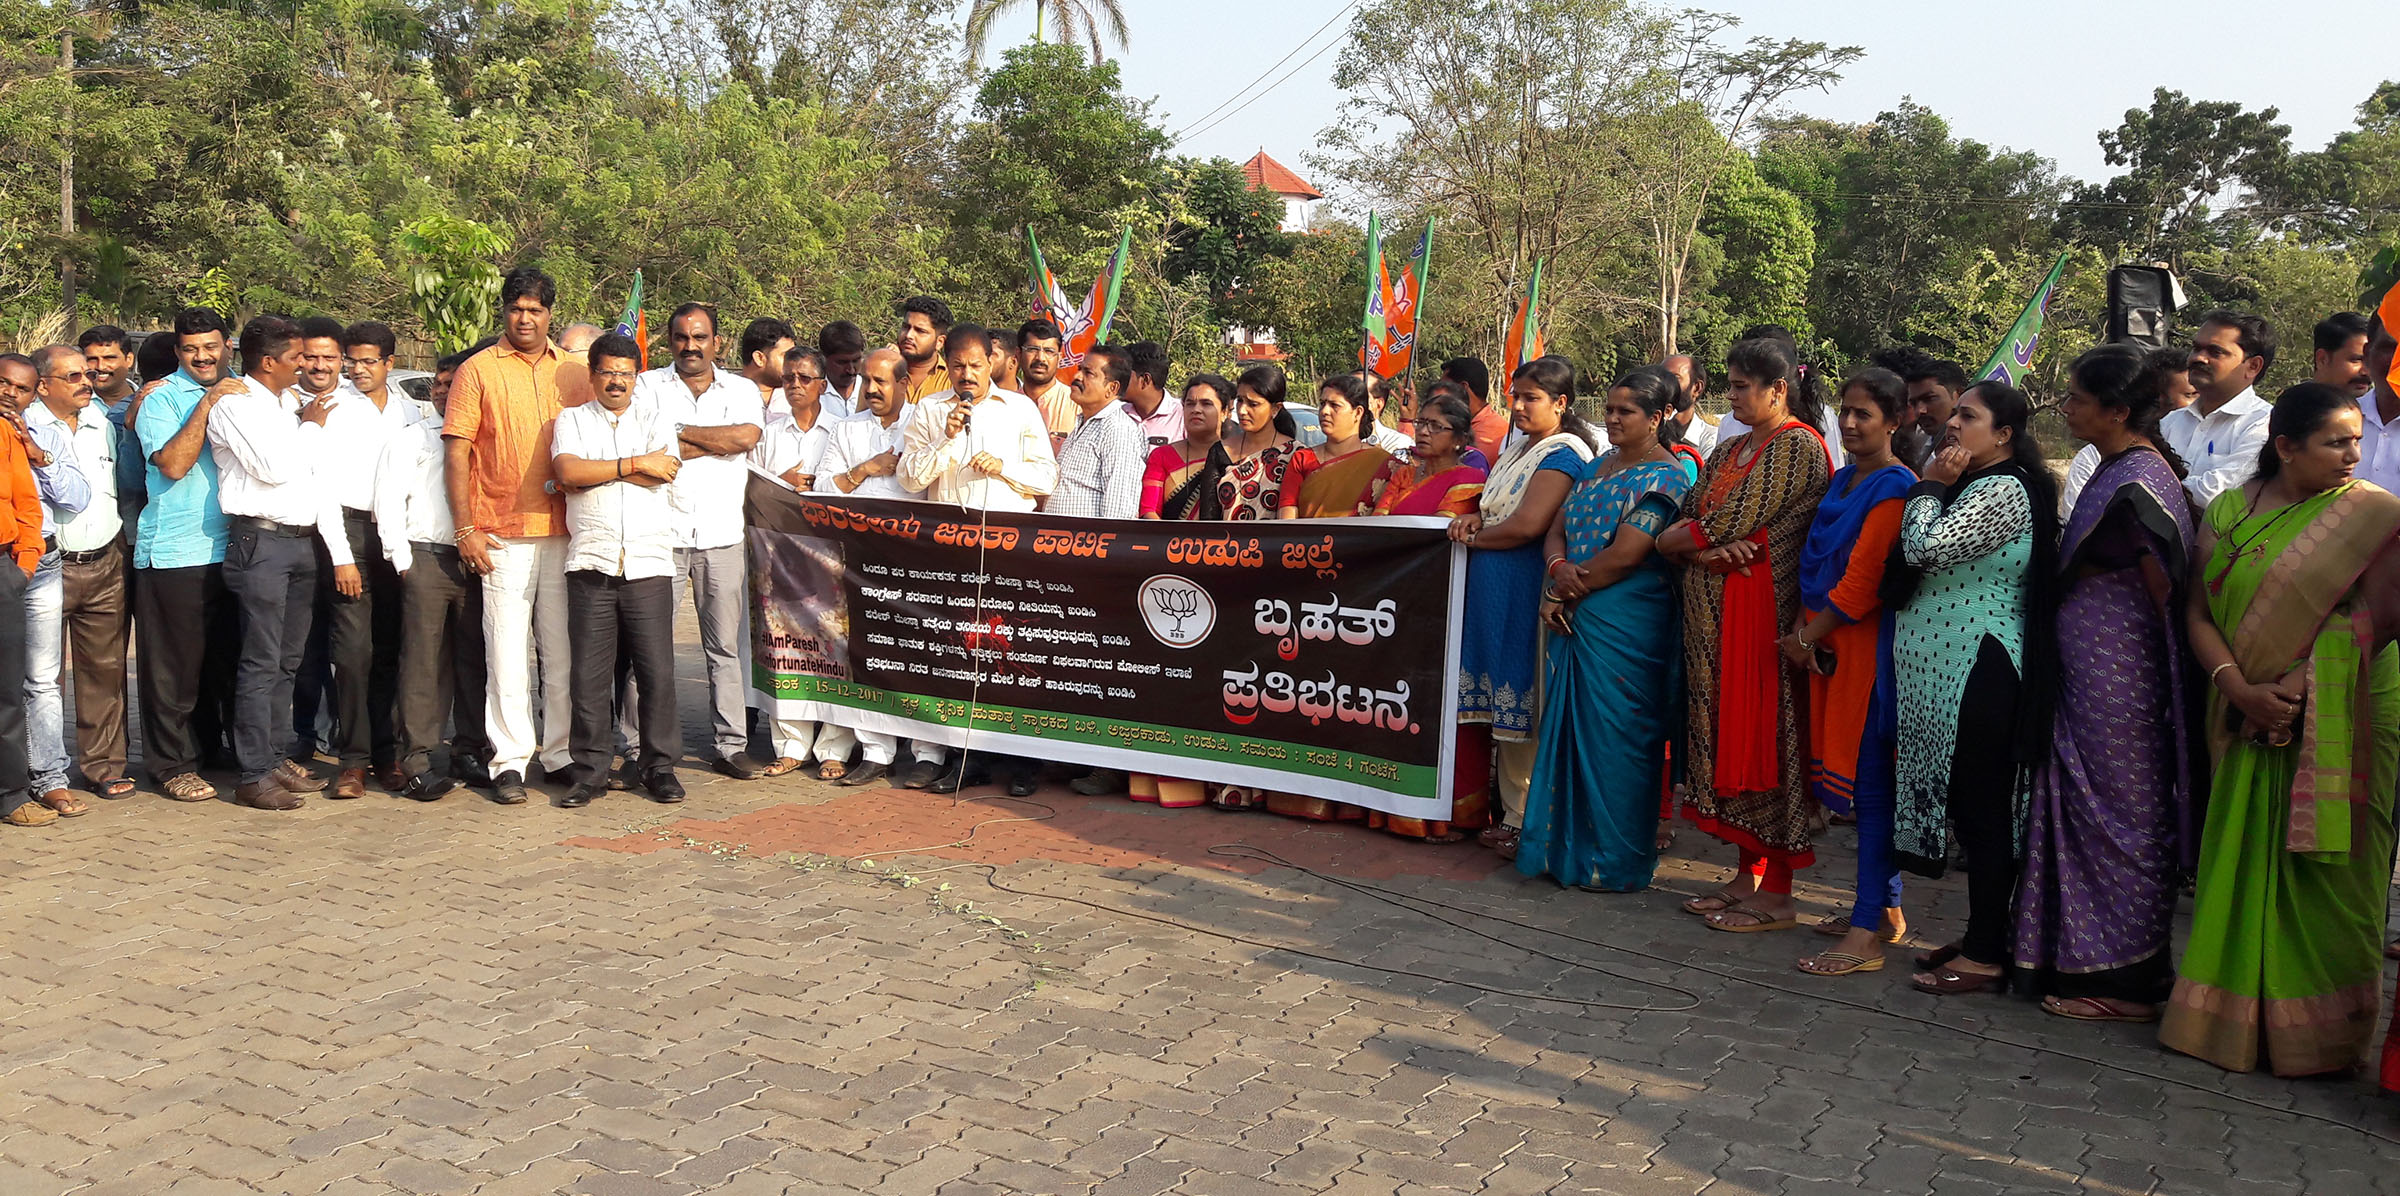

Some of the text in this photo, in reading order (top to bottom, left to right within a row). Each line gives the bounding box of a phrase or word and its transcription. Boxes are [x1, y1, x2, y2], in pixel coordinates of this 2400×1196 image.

[800, 499, 921, 540] ಭಾರತೀಯ
[933, 517, 1020, 550] ಜನತಾ
[1033, 529, 1117, 559] ಪಾರ್ಟಿ
[1166, 529, 1264, 568] ಉಡುಪಿ
[1281, 534, 1343, 581] ಜಿಲ್ಲೆ.
[905, 590, 944, 605] ಸರಕಾರದ
[1018, 601, 1065, 619] ನೀತಿಯನ್ನು
[1067, 605, 1098, 618] ಖಂಡಿಸಿ
[1254, 591, 1397, 661] ಬೃಹತ್
[908, 662, 929, 674] ನಿರತ
[990, 673, 1015, 685] ಮೇಲೆ
[1107, 686, 1136, 699] ಖಂಡಿಸಿ
[1006, 650, 1049, 665] ಸಂಪೂರ್ಣ
[1222, 659, 1421, 735] ಪ್ರತಿಭಟನೆ.
[935, 699, 965, 722] ಸೈನಿಕ
[1022, 713, 1069, 735] ಸ್ಮಾರಕದ
[1239, 740, 1287, 759] ಸಮಯ
[1306, 750, 1339, 767] ಸಂಜೆ
[1344, 756, 1354, 770] 4
